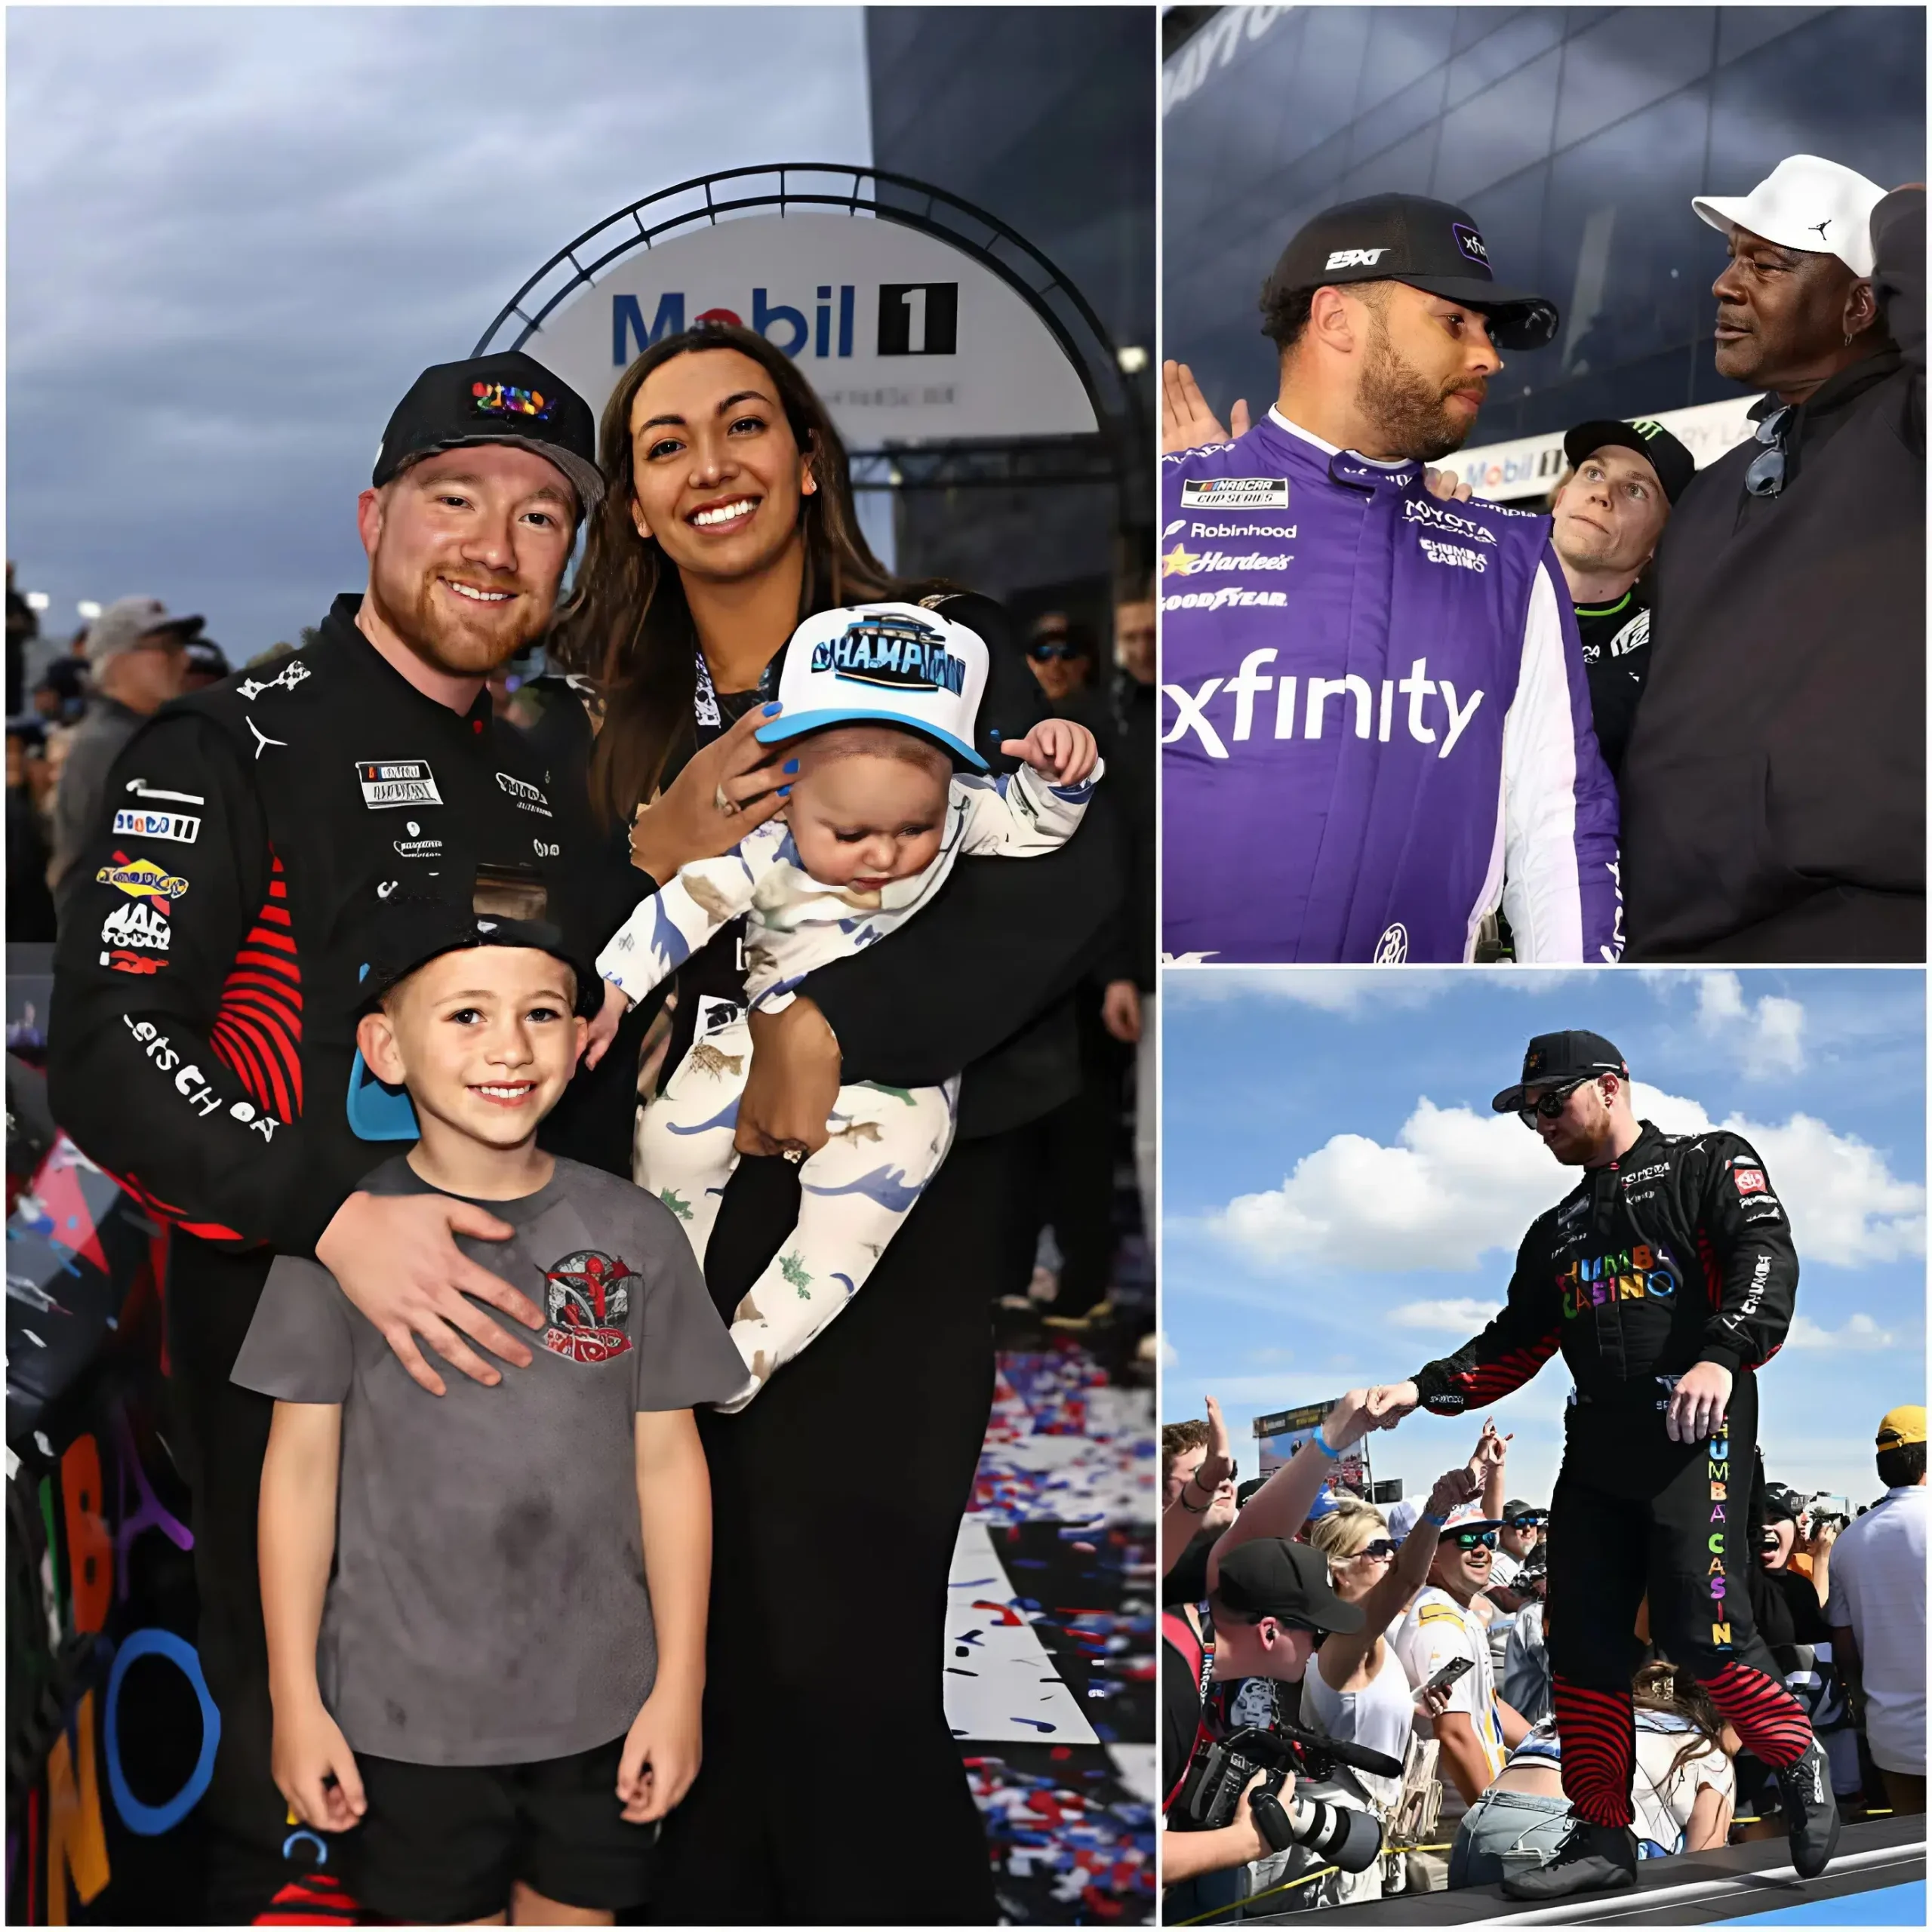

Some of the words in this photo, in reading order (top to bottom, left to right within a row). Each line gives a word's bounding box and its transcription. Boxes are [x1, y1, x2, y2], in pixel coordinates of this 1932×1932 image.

[612, 285, 855, 366] Mbil
[1191, 522, 1297, 538] Robinhood
[1404, 500, 1497, 543] TOYOTA
[1189, 552, 1294, 574] Hardee's
[1162, 648, 1484, 758] xfinity
[1563, 1270, 1675, 1319] CASINO
[1708, 1533, 1734, 1651] CASIN
